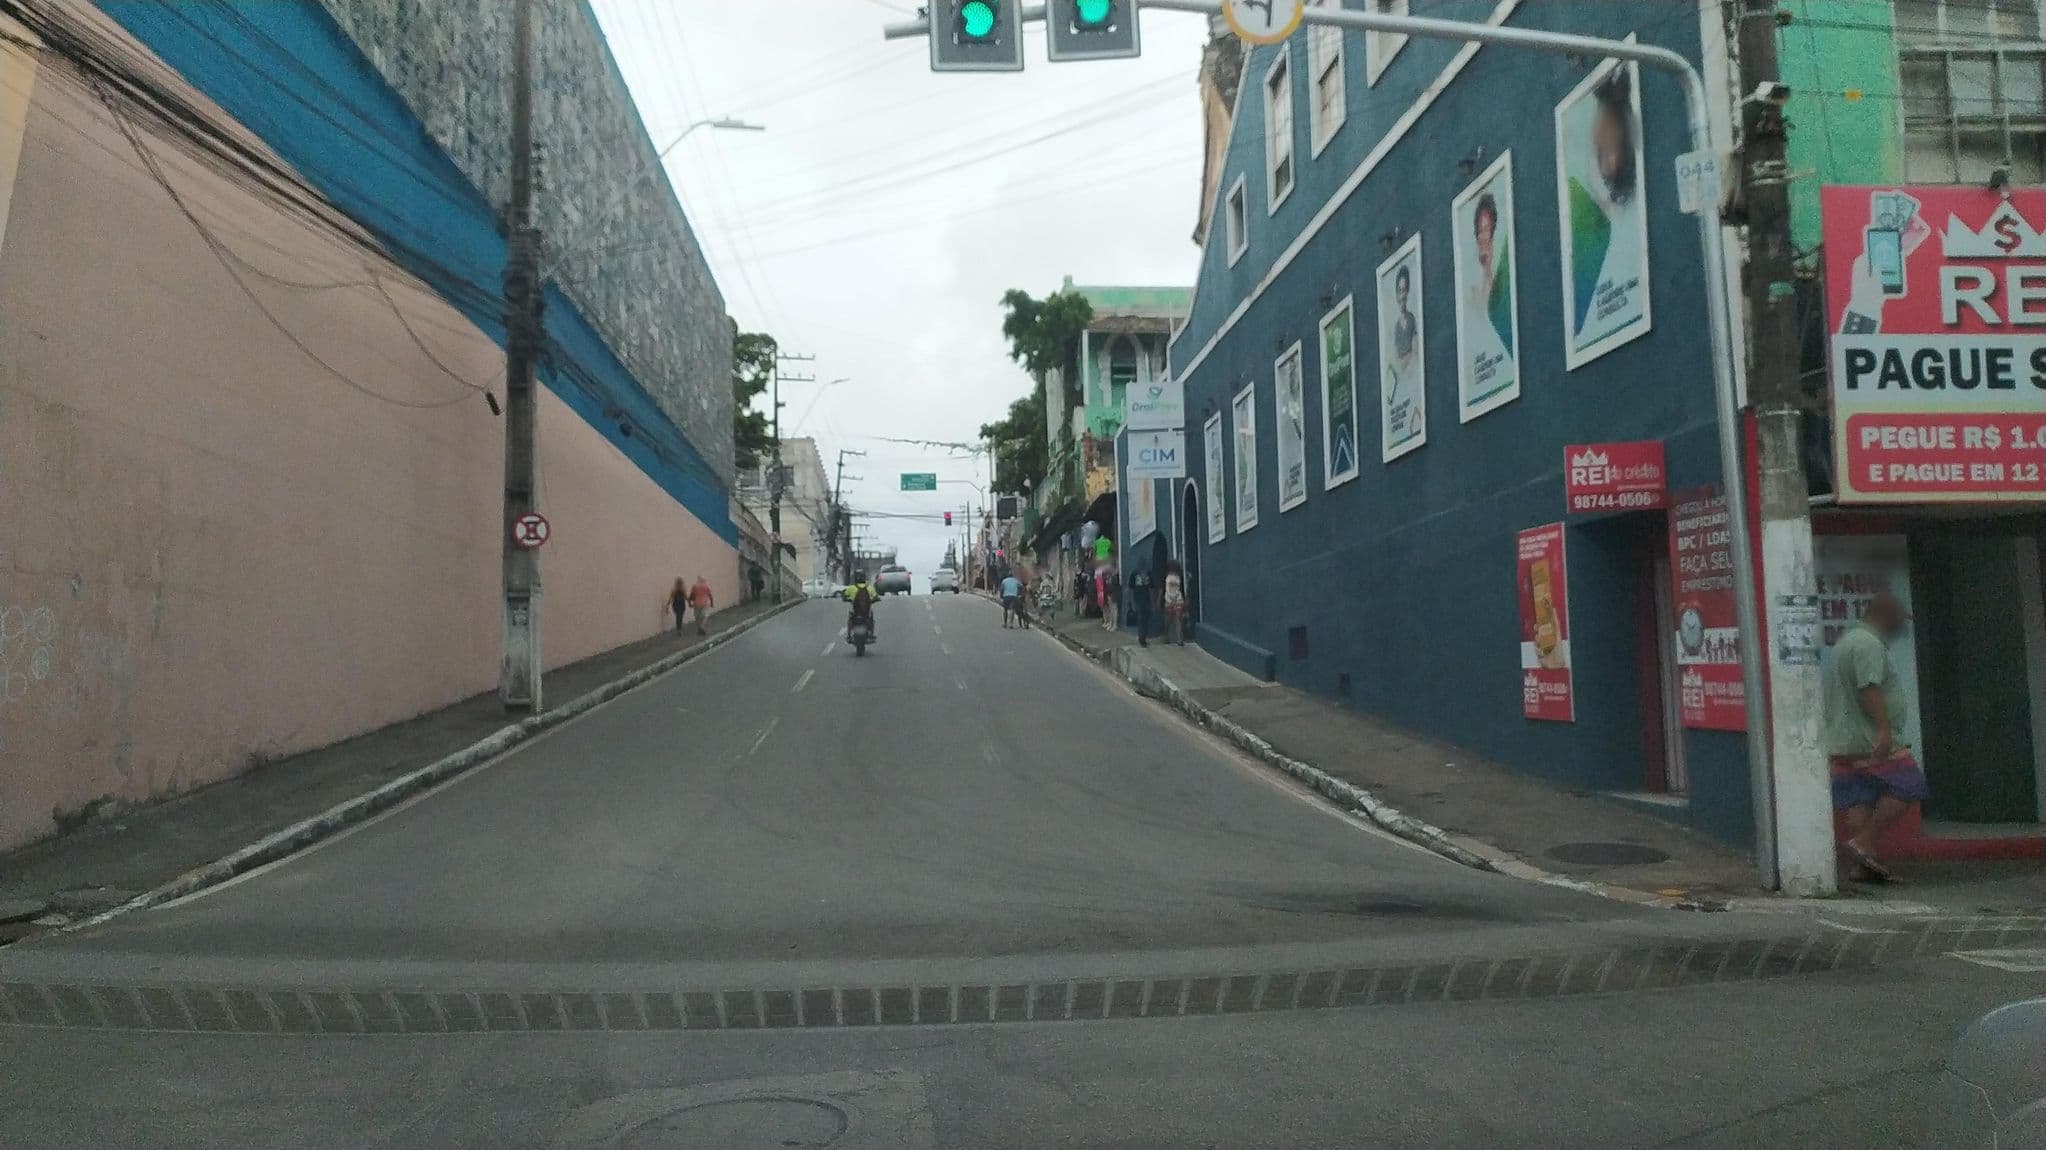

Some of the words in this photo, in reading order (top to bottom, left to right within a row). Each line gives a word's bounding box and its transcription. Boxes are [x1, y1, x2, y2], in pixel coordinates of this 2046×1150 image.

[1845, 347, 2016, 390] PAGUE
[1861, 426, 1956, 449] PEGUE
[1963, 424, 2002, 451] R$
[1139, 448, 1175, 463] CIM
[1571, 466, 1610, 486] REI
[1869, 463, 1883, 482] E
[1889, 463, 1964, 481] PAGUE
[1970, 463, 2004, 481] EM
[2011, 463, 2040, 481] 12
[1574, 491, 1651, 509] 98744-0506
